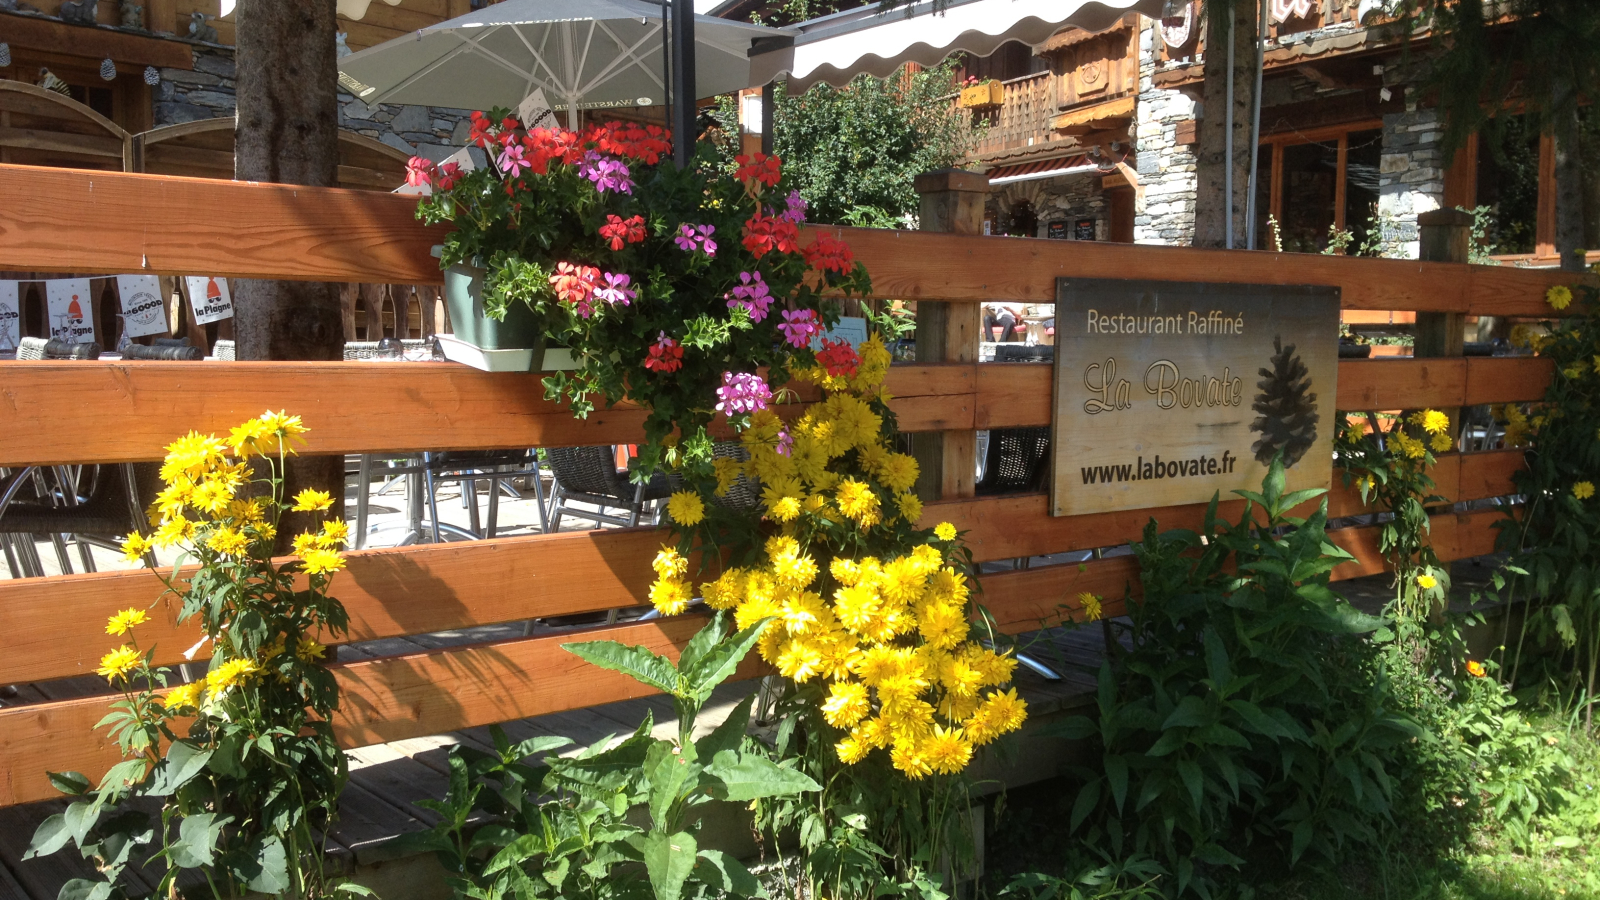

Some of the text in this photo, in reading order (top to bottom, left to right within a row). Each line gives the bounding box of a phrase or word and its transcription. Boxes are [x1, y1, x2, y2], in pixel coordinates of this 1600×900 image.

[195, 302, 231, 316] la Plagne
[1087, 309, 1244, 334] Restaurant Raffiné
[62, 326, 92, 336] Pagne
[1083, 357, 1243, 414] La Bovate
[1081, 450, 1237, 484] www.labovate.fr
